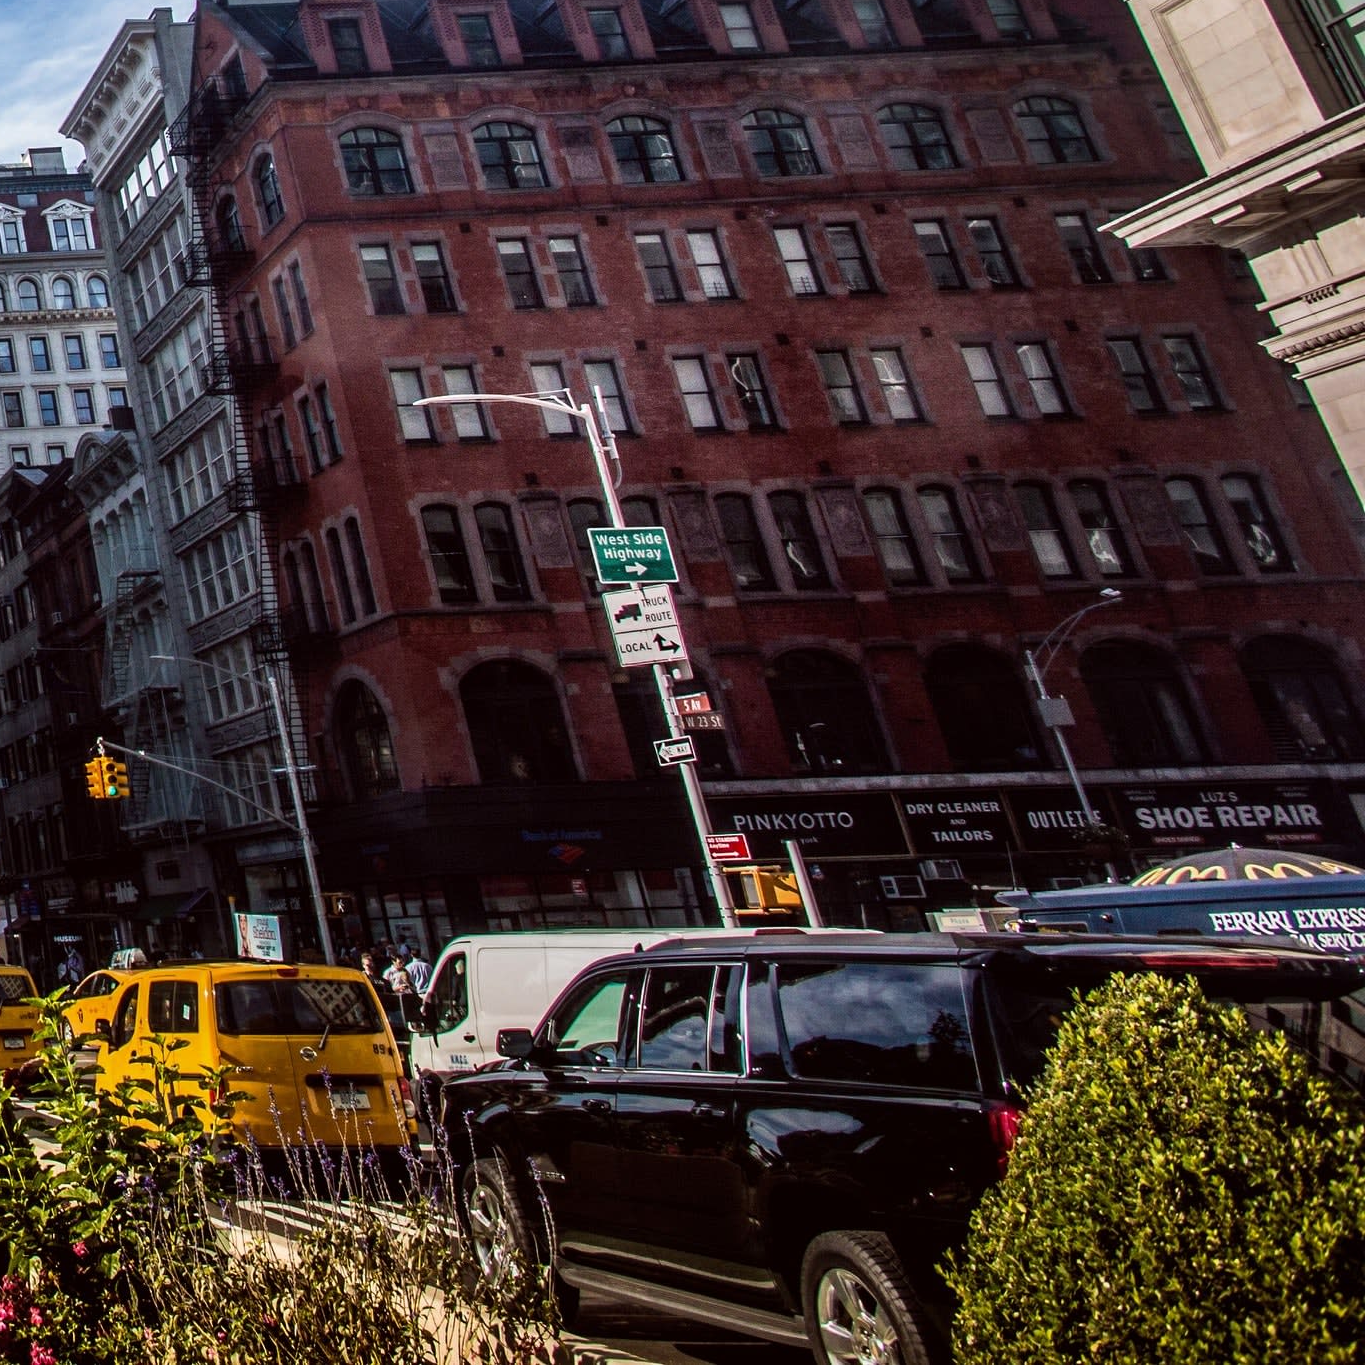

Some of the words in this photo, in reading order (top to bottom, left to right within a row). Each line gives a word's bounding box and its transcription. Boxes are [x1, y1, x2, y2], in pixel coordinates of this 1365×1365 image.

[595, 534, 629, 545] West
[634, 533, 663, 545] Side
[603, 547, 662, 562] Highway
[641, 595, 668, 608] TRUCK
[645, 610, 672, 623] ROUTE
[620, 641, 653, 654] LOCAL
[684, 700, 691, 712] 5
[685, 716, 695, 728] W
[697, 716, 709, 728] 23
[710, 715, 722, 728] St
[663, 747, 672, 756] ONE
[677, 745, 689, 754] WAY
[906, 803, 934, 815] DRY
[937, 801, 1001, 814] CLEANER
[733, 811, 854, 831] PINKYOTTO
[949, 818, 967, 826] AND
[1027, 809, 1101, 829] OUTLETE
[1135, 806, 1214, 829] SHOE
[1215, 803, 1323, 828] REPAIR
[931, 830, 994, 843] TAILORS
[1208, 909, 1298, 935] FERRARI
[1293, 907, 1365, 933] EXPRESS
